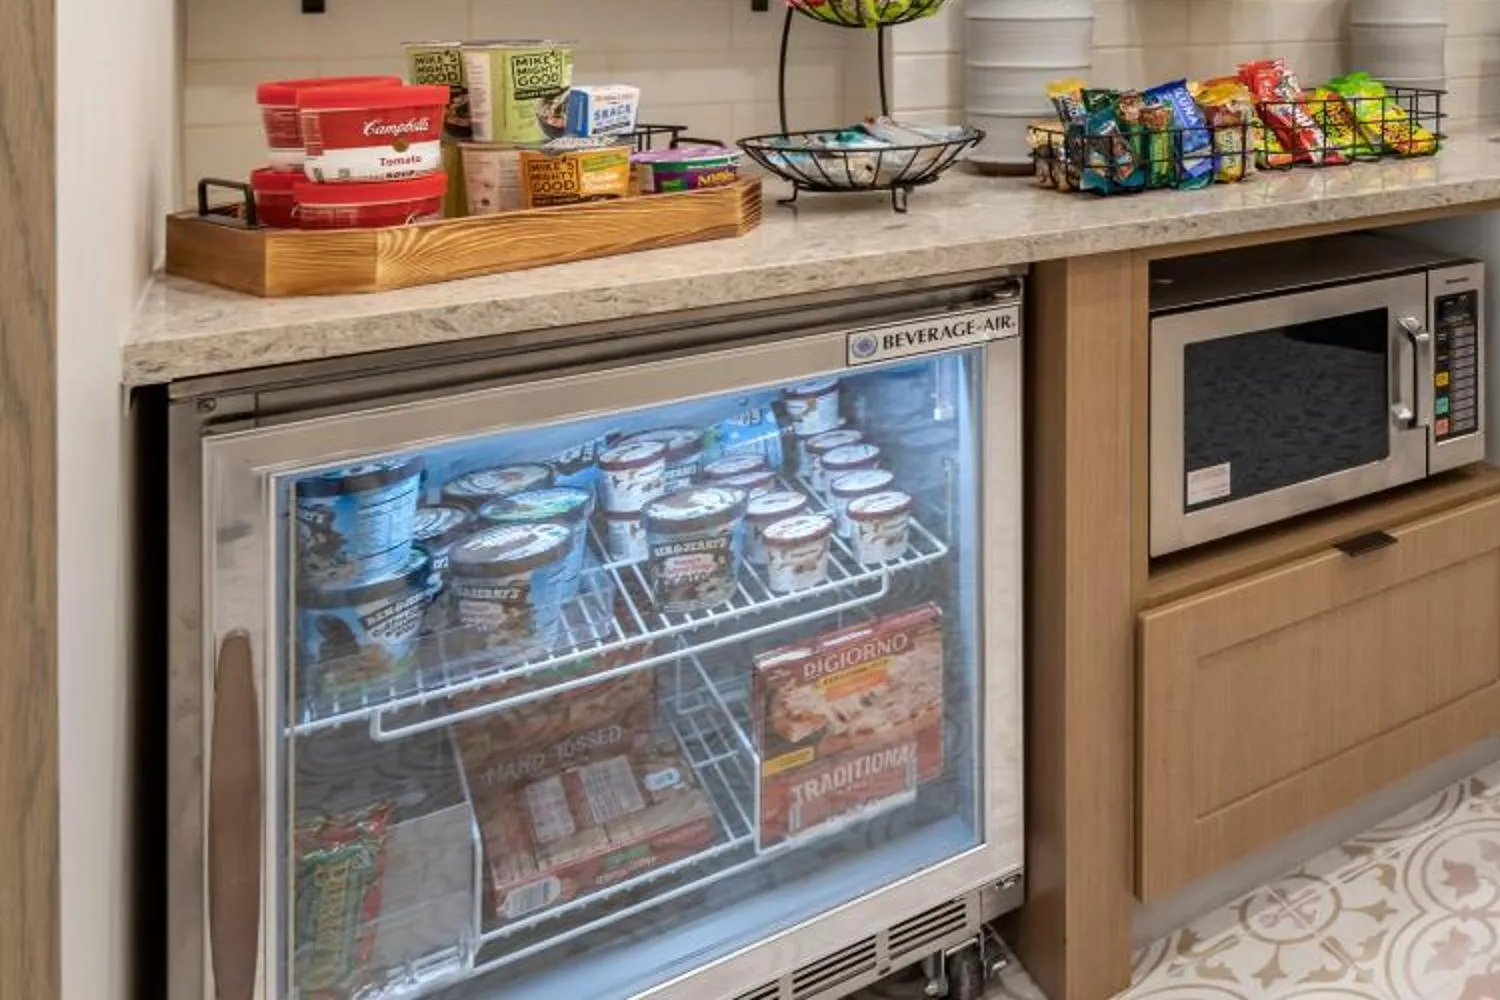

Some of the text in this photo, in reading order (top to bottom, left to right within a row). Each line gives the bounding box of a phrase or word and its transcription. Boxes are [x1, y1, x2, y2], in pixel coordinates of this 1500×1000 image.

[515, 51, 561, 67] MIKE'S
[516, 64, 560, 77] MIGHTY
[517, 73, 560, 87] GOOD
[803, 632, 908, 680] DIGIORNO
